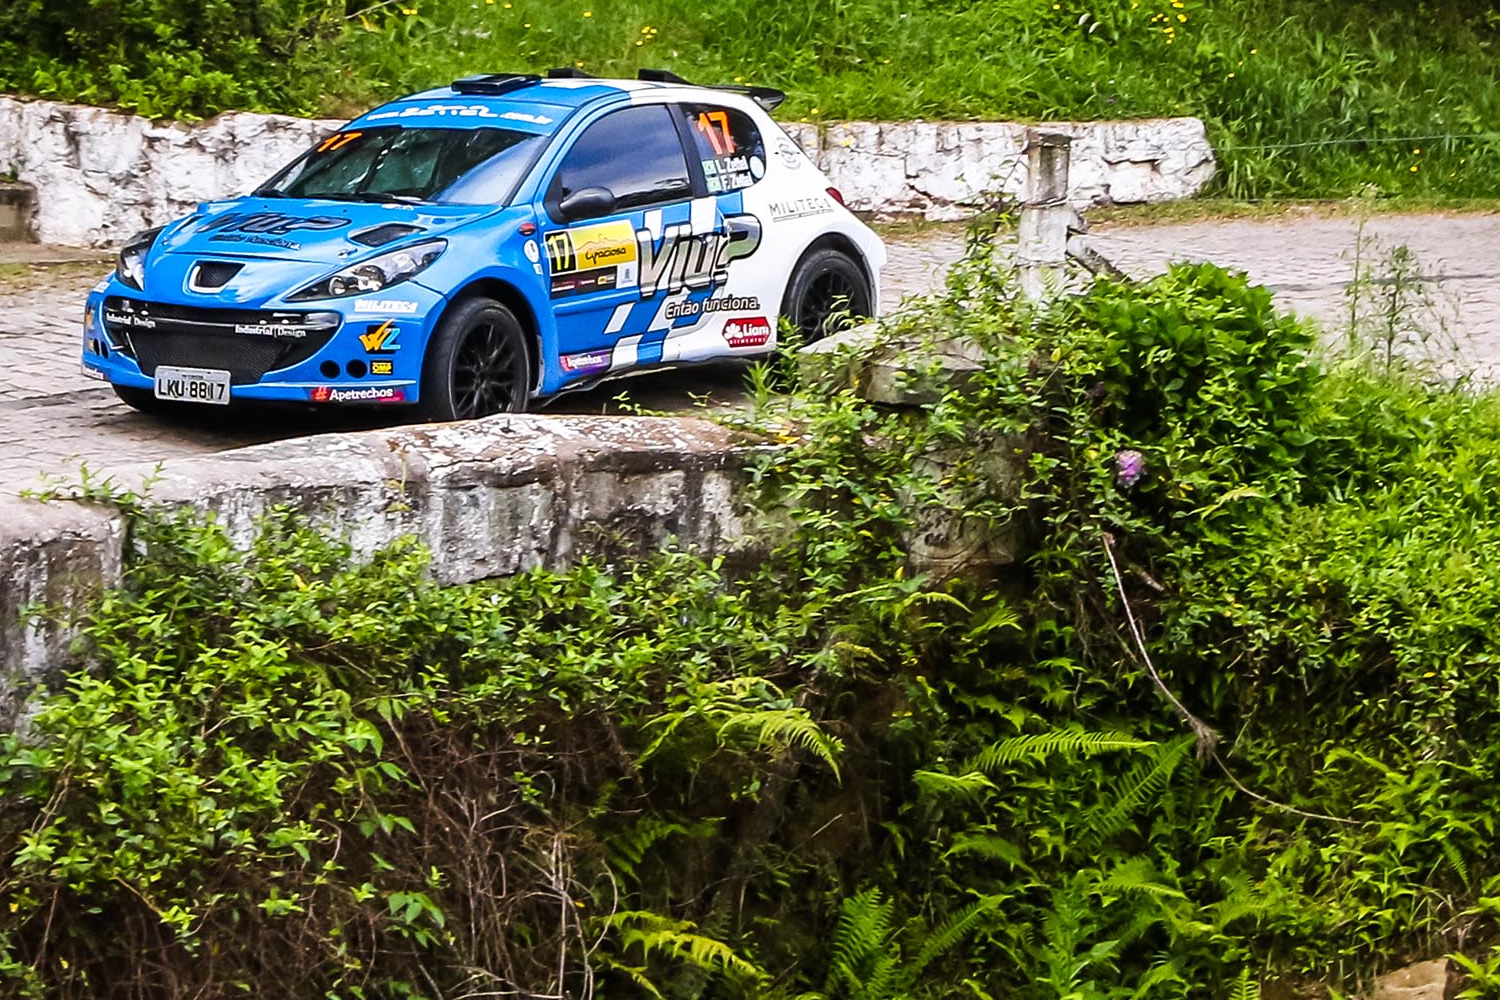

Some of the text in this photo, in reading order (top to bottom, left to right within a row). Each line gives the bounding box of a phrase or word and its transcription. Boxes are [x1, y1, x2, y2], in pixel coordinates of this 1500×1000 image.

[316, 130, 364, 153] 17
[695, 110, 736, 156] 17
[547, 232, 571, 271] 17
[329, 387, 394, 402] Apetrechos
